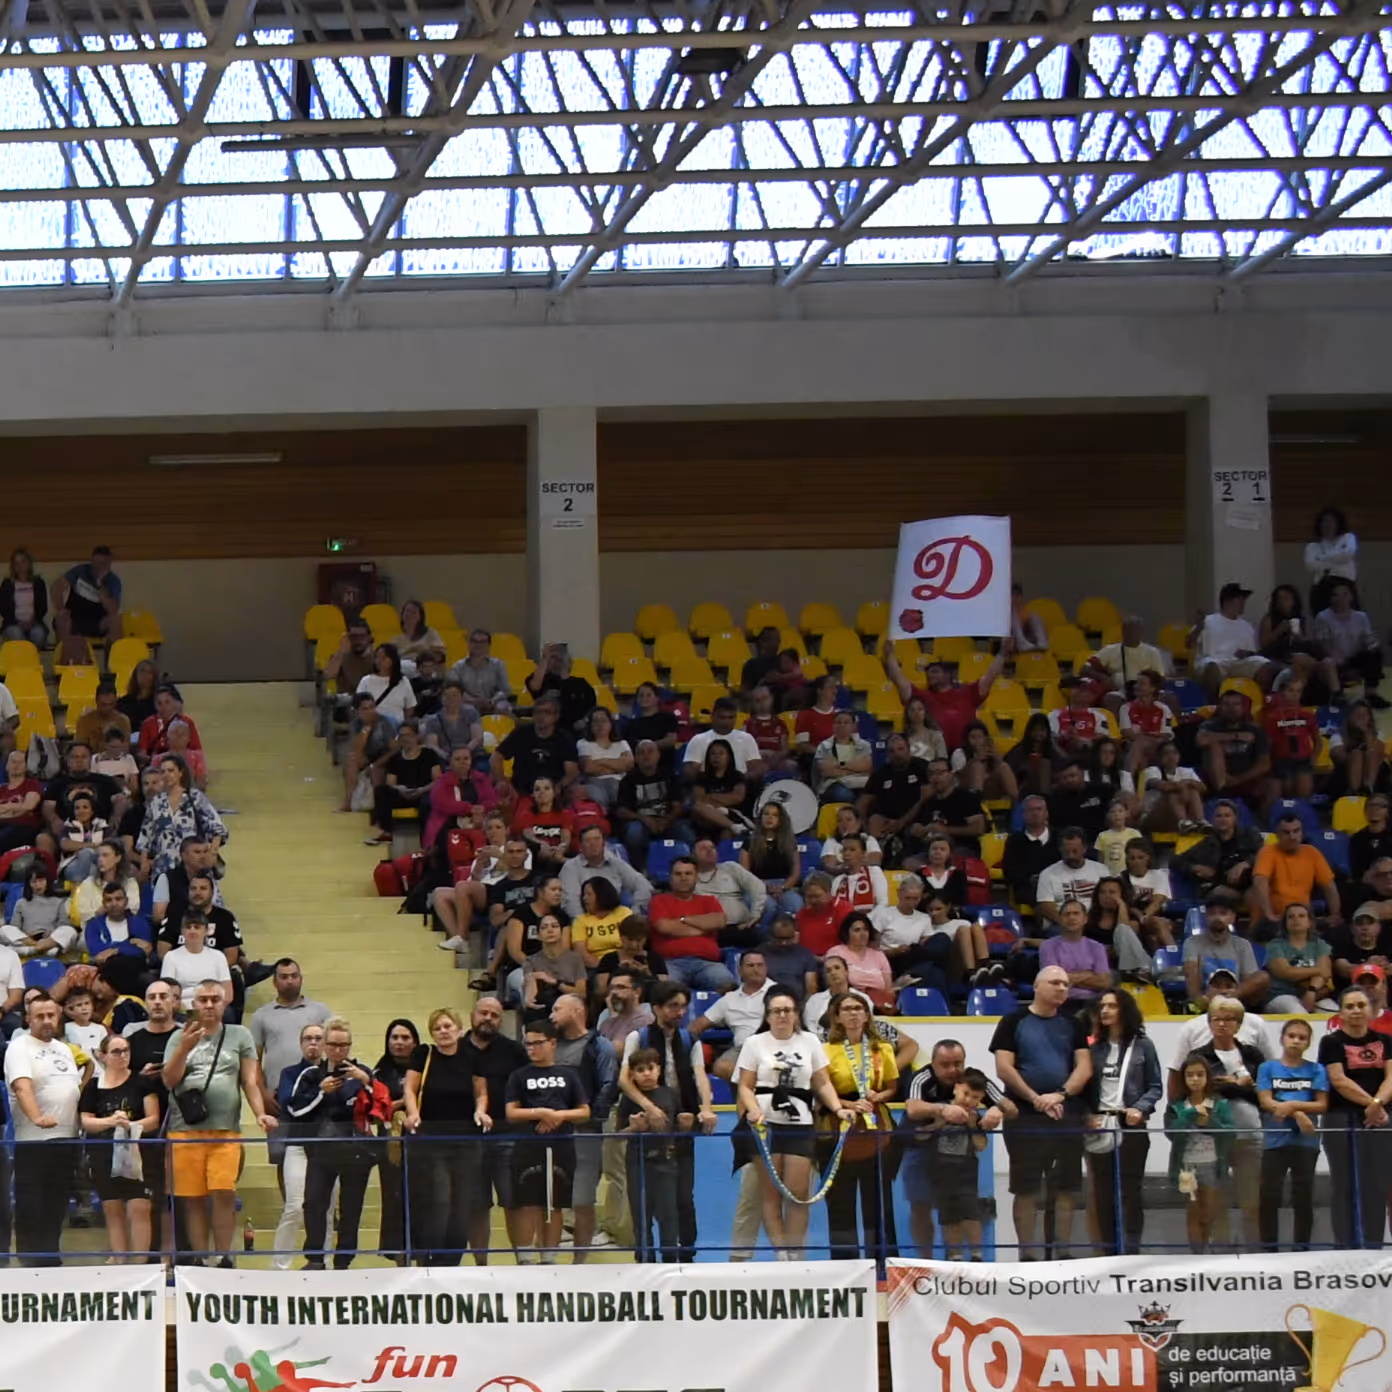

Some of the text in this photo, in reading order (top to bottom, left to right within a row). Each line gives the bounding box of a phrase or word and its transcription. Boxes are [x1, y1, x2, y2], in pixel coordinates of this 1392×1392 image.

[1214, 469, 1267, 484] SECTOR
[541, 481, 595, 495] SECTOR
[1221, 483, 1262, 497] 2 1
[562, 498, 574, 512] 2
[912, 534, 994, 601] D
[526, 1076, 566, 1091] BOSS
[1272, 1078, 1313, 1090] Kempa
[914, 1269, 1392, 1300] Clubul Sportiv Transilvania Brasov
[185, 1286, 867, 1325] YOUTH INTERNATIONAL HANDBALL TOURNAMENT
[361, 1345, 458, 1384] fun
[1168, 1345, 1272, 1365] de educație
[1037, 1348, 1145, 1387] ANI
[1169, 1366, 1296, 1386] și performanță
